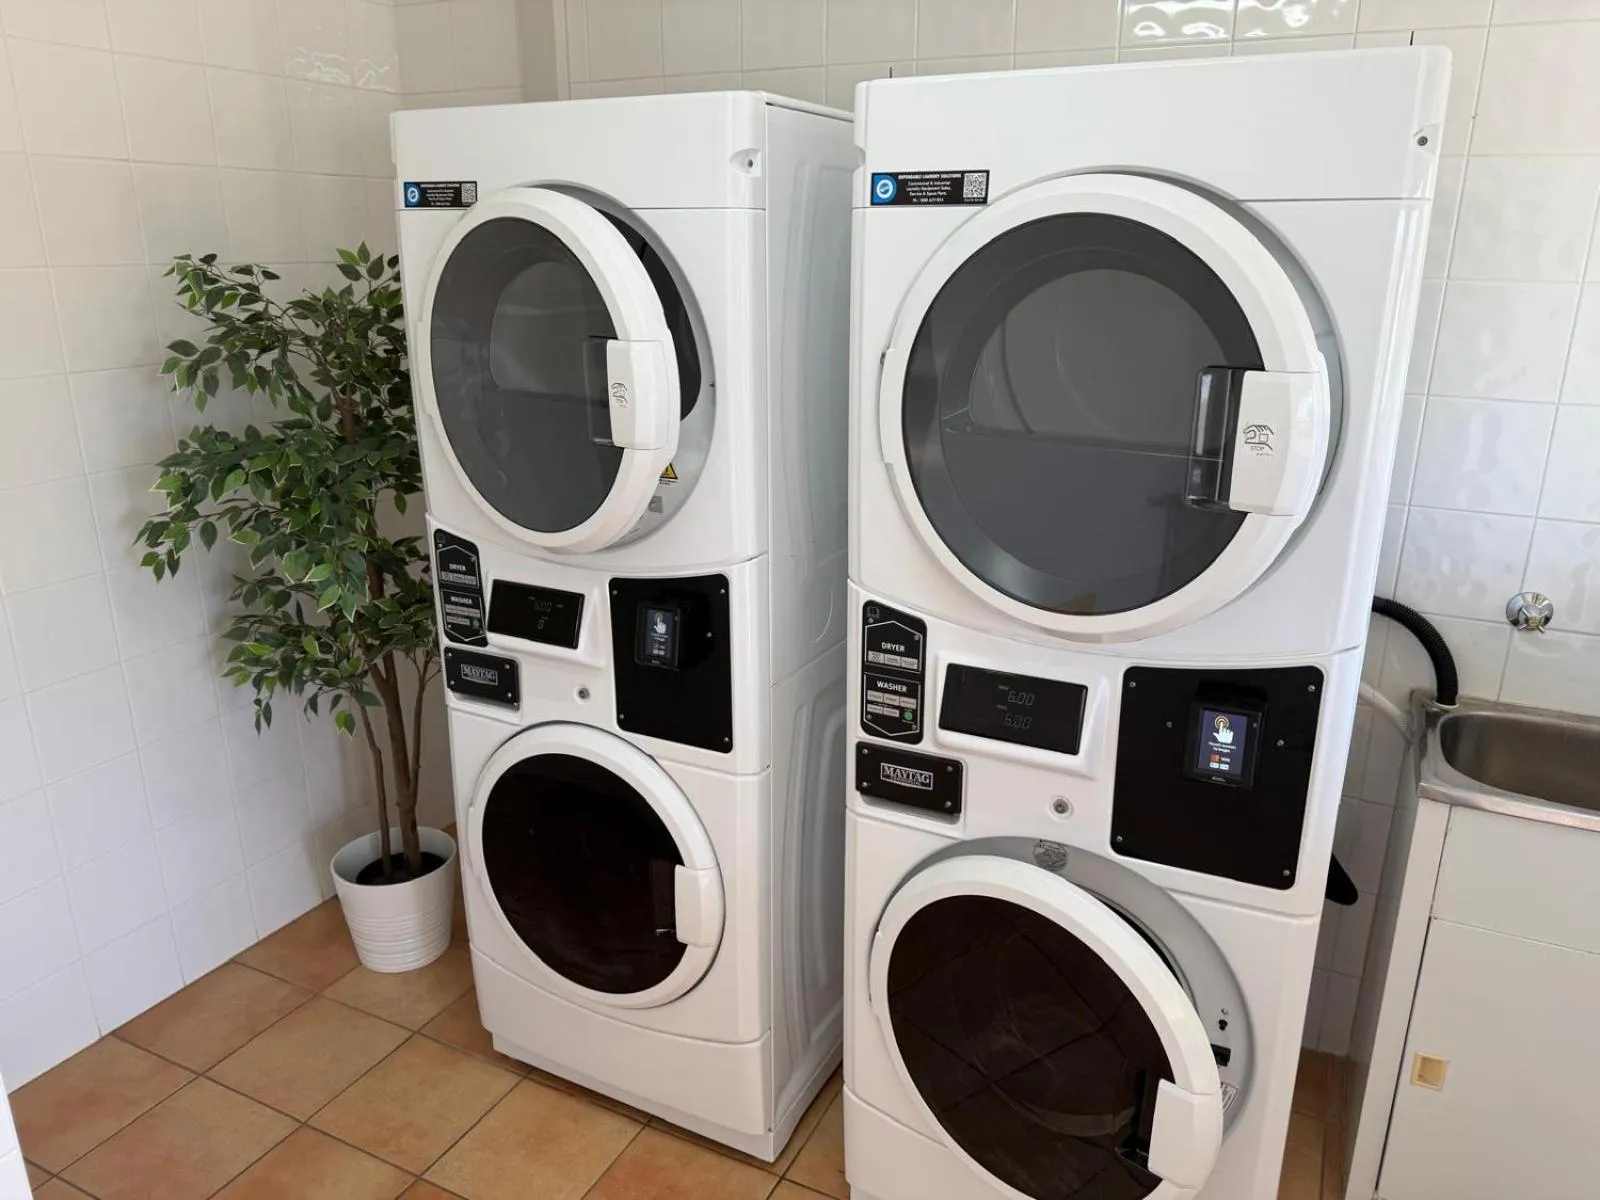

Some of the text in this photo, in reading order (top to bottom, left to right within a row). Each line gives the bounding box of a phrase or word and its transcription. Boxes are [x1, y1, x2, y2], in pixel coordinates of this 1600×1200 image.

[449, 563, 466, 571] DRYER
[881, 642, 905, 653] DRYER
[463, 666, 496, 680] MAYTAG
[877, 680, 907, 693] WASHER
[884, 766, 930, 784] MAYTAG
